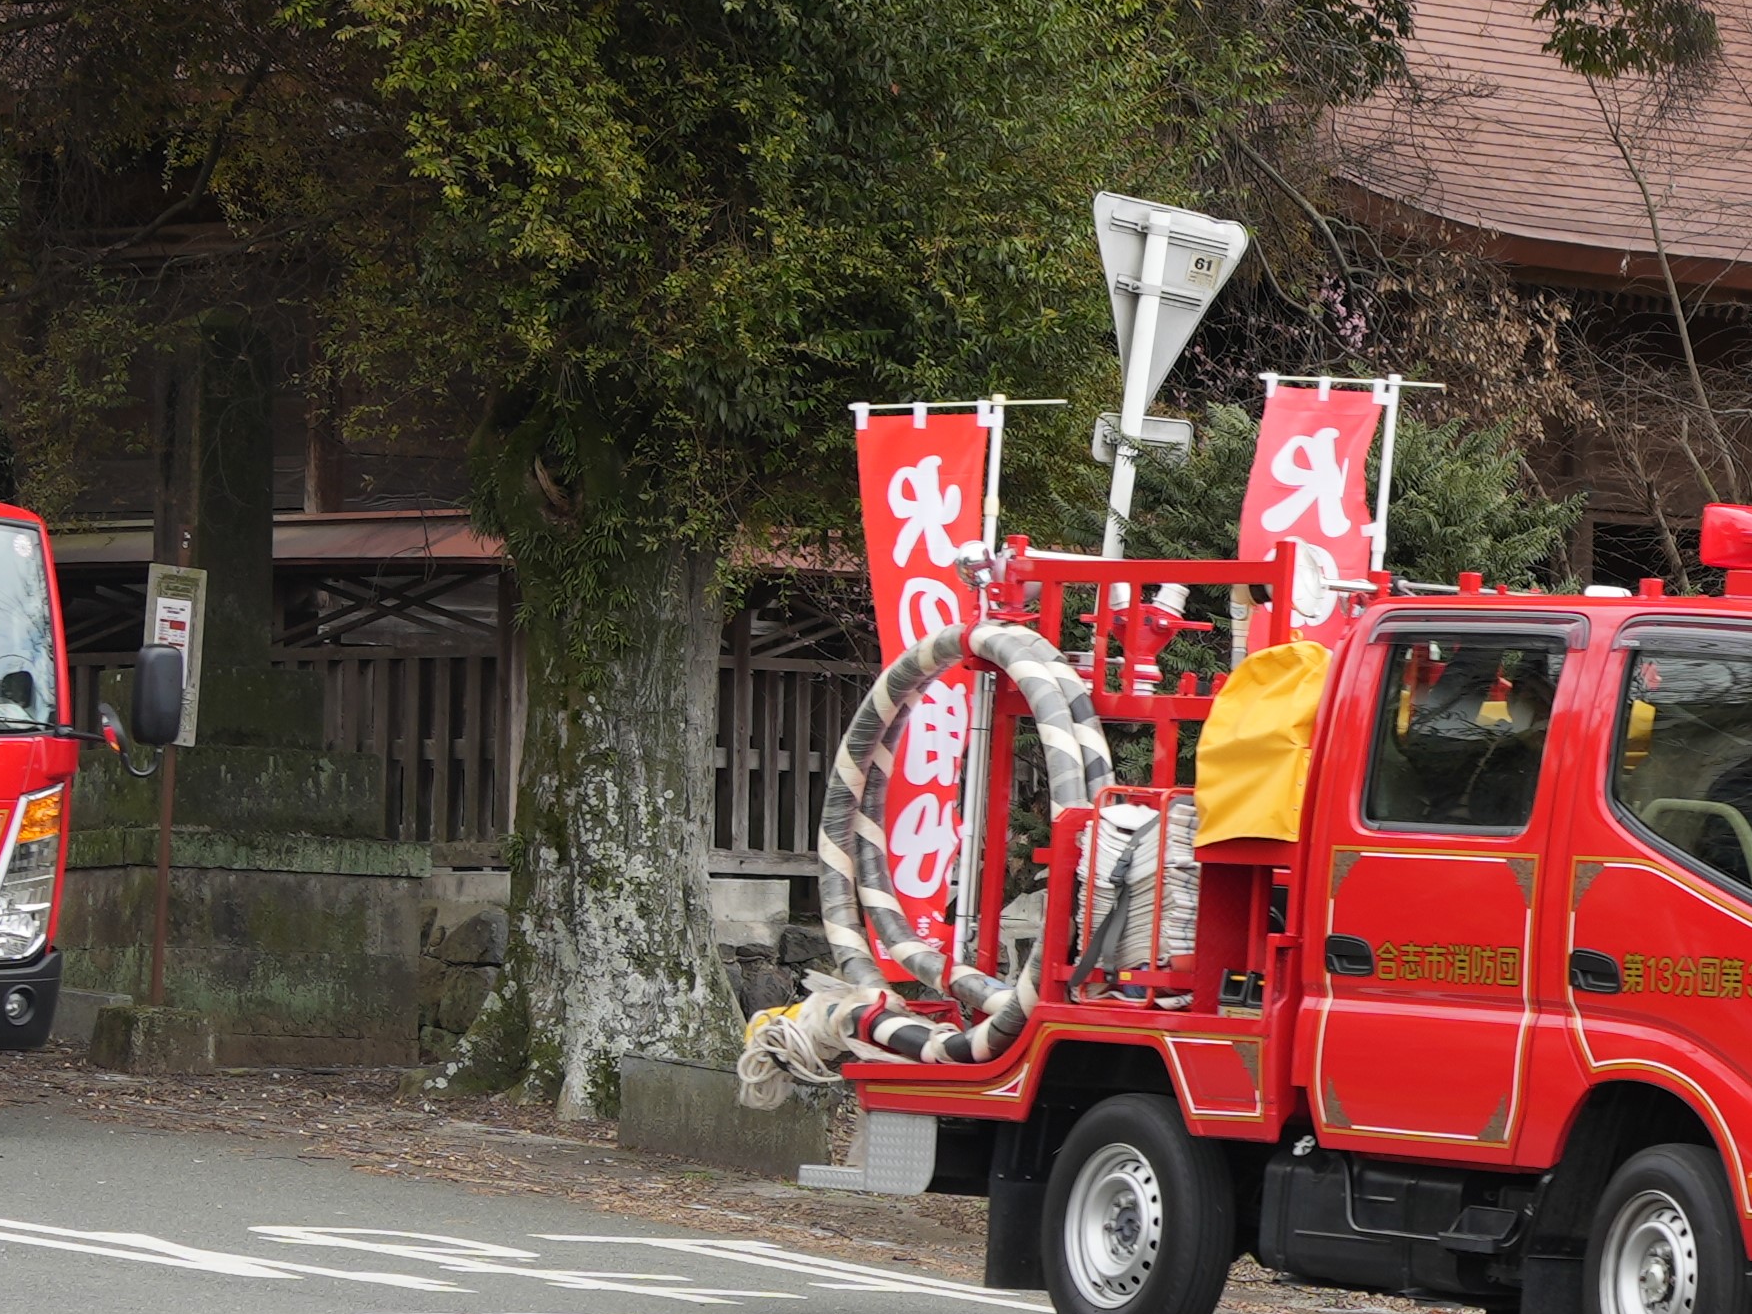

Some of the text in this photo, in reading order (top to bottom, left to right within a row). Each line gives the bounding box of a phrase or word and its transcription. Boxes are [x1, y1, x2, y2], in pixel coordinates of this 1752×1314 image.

[1194, 257, 1213, 272] 61
[1375, 941, 1520, 988] 合志市消防団
